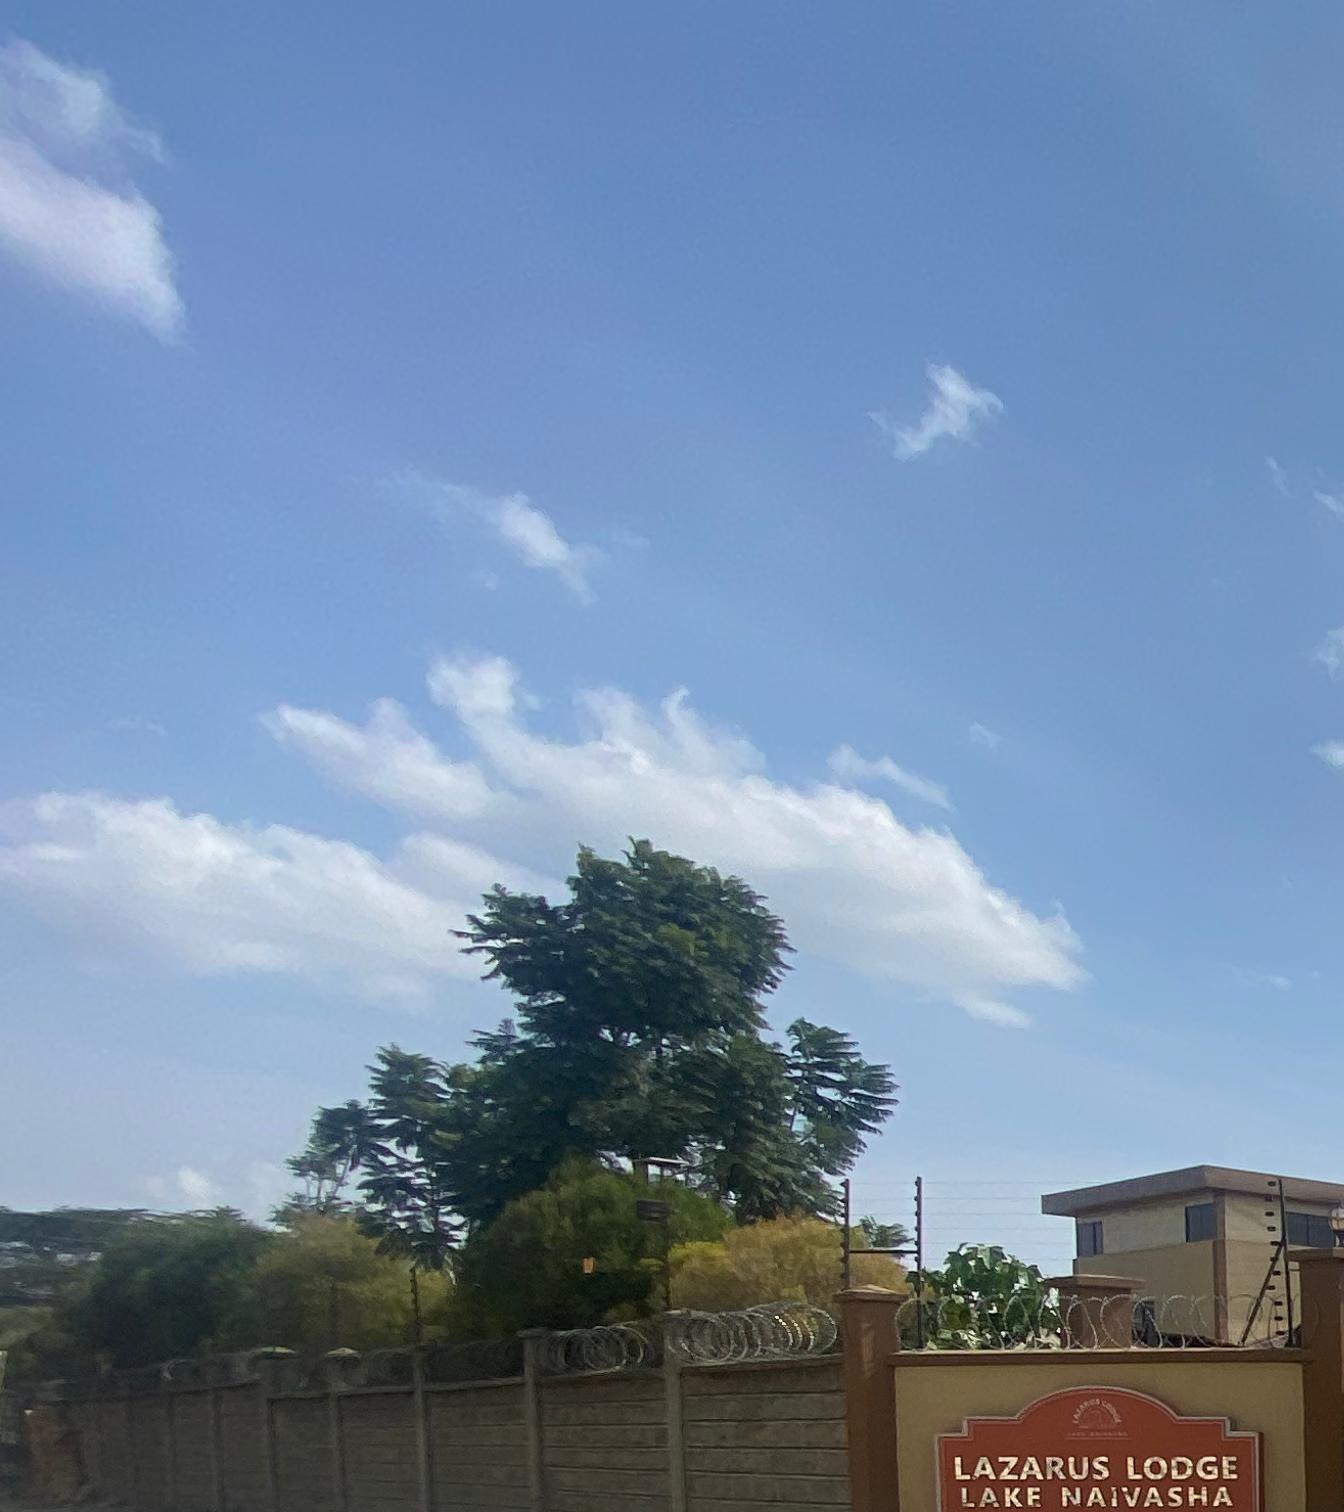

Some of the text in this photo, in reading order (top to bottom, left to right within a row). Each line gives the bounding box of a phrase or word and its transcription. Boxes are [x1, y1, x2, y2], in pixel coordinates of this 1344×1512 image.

[953, 1455, 1239, 1481] LAZARUS LODGE
[960, 1486, 1233, 1508] LAKE NAIVASHA
